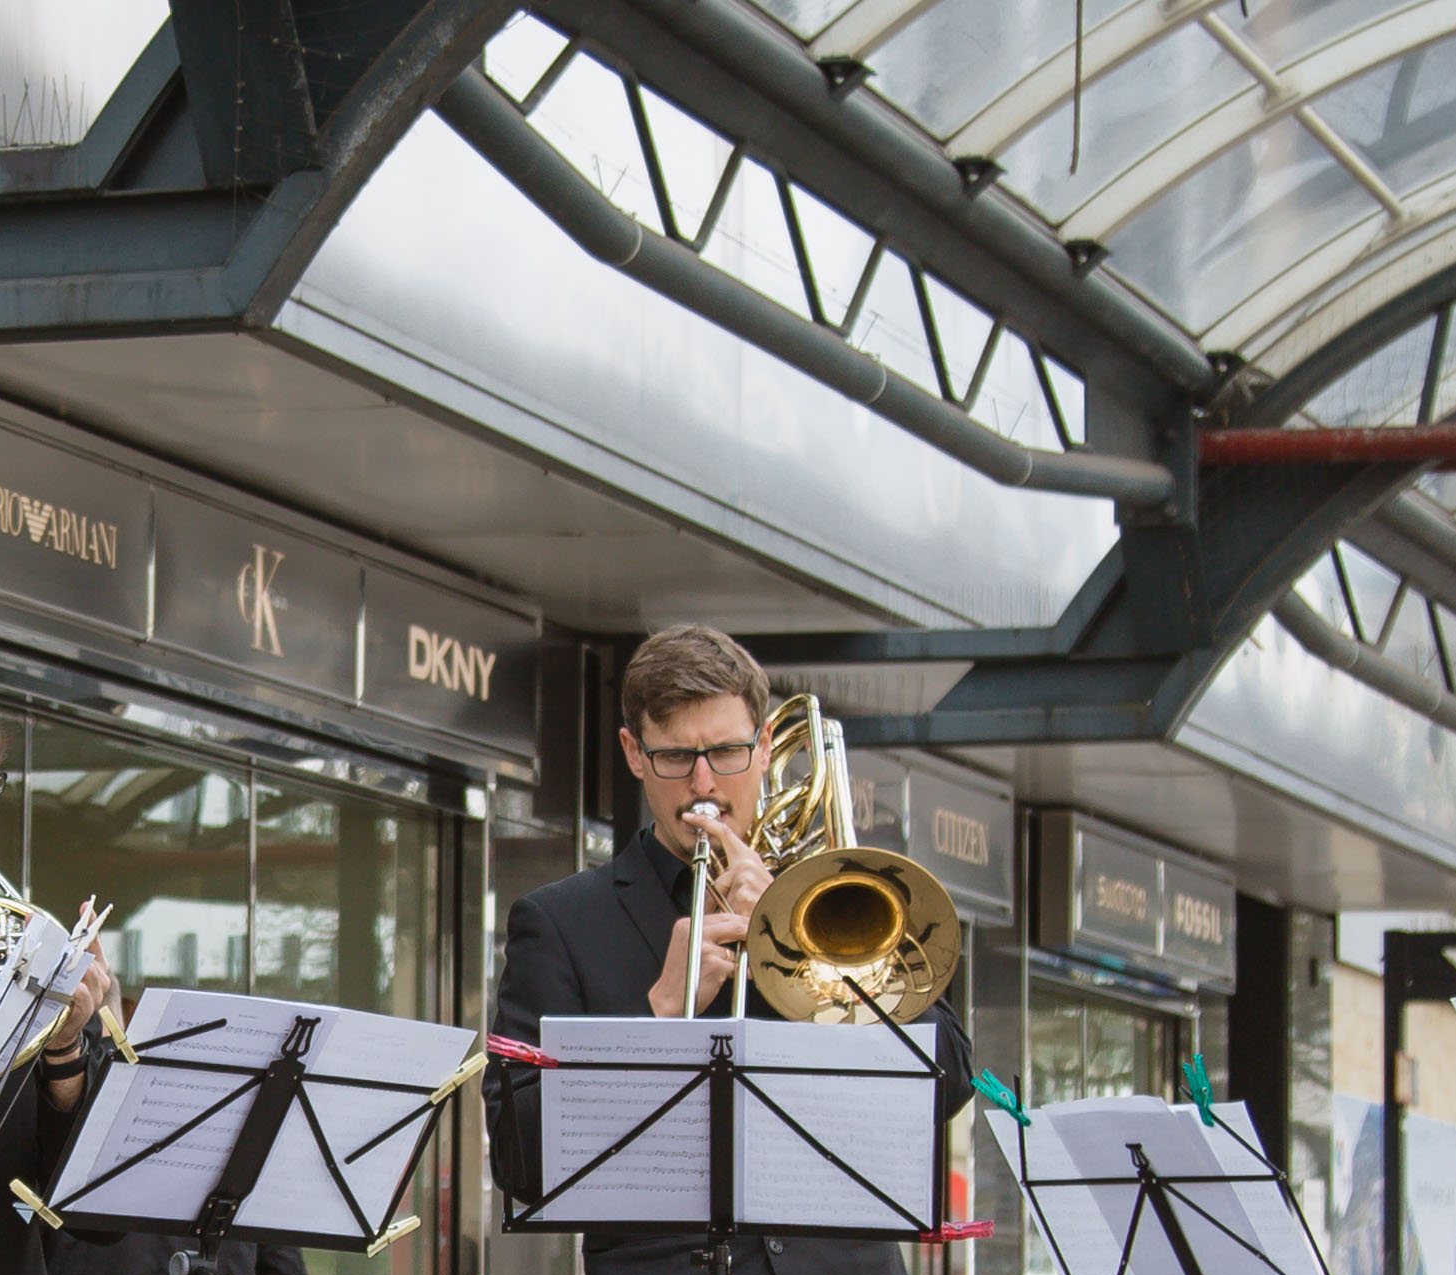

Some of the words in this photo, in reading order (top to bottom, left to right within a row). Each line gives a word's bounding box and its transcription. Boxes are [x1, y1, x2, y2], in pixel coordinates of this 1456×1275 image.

[44, 507, 118, 570] ARMANI
[408, 622, 497, 702] DKNY
[934, 808, 990, 867] CITIZEN
[1176, 893, 1224, 946] FOSSIL
